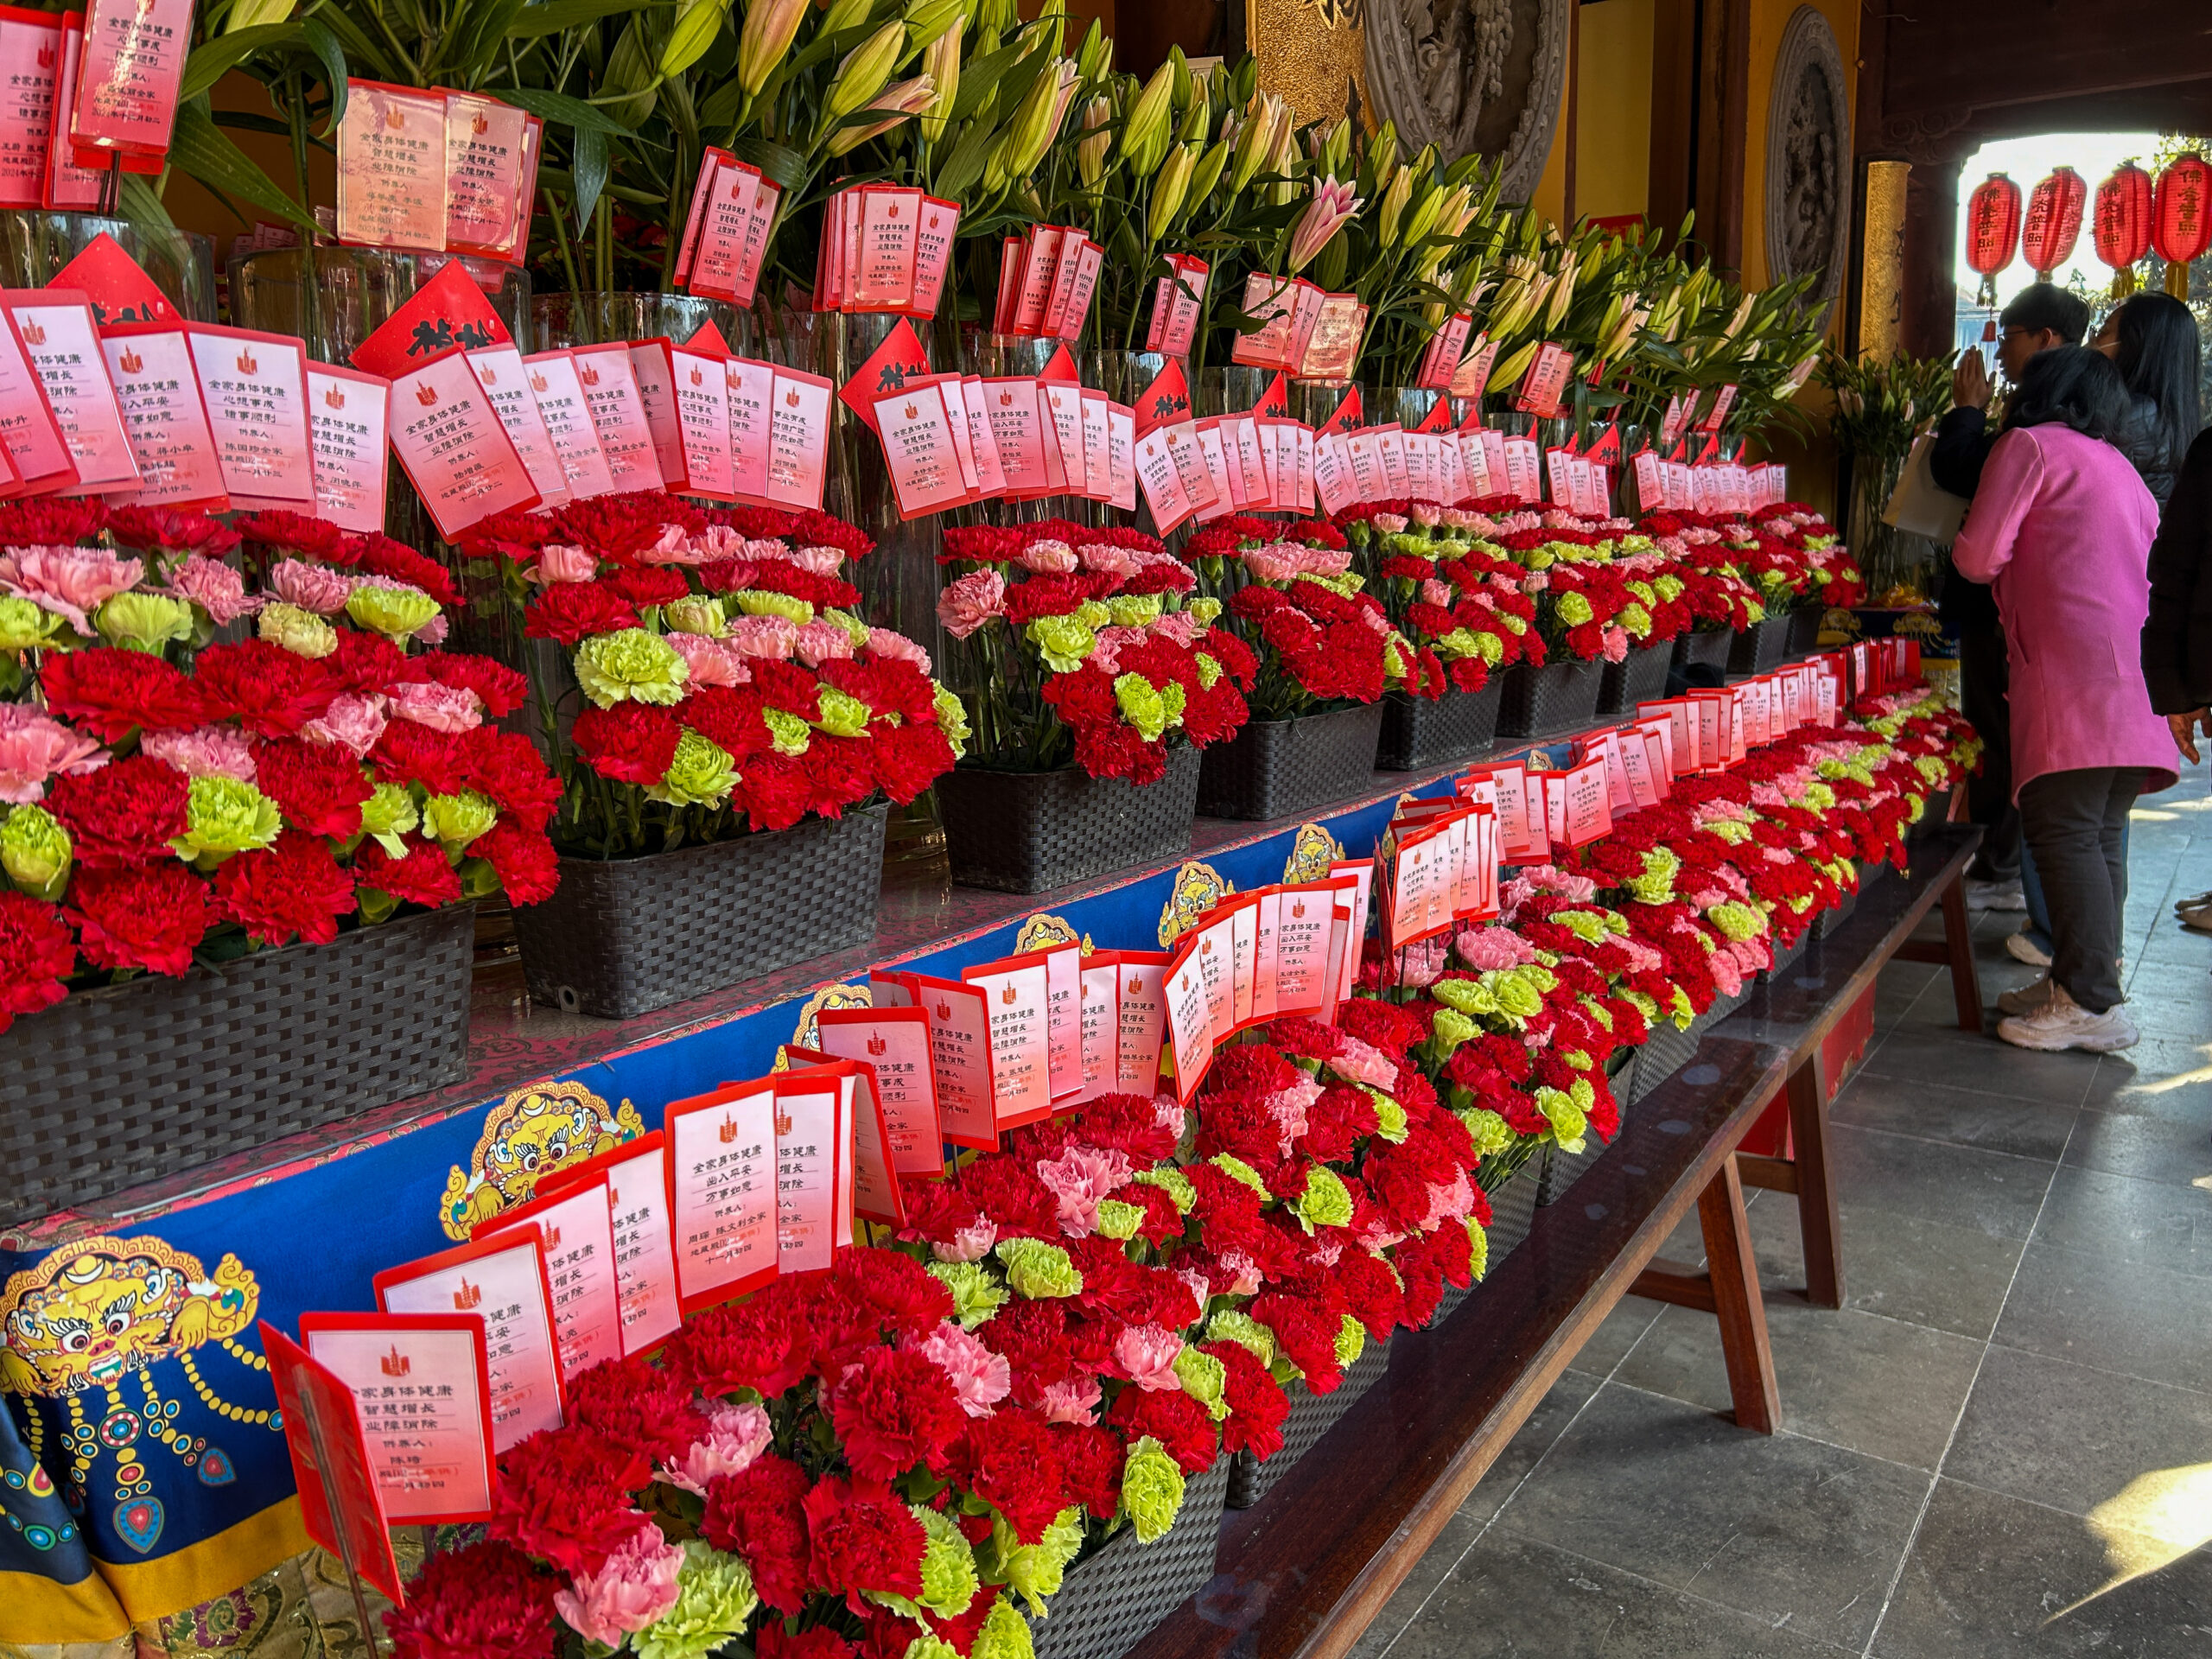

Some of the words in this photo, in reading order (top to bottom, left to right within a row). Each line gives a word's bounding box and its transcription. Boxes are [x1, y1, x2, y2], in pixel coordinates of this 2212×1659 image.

[109, 17, 173, 38] 全家体健康
[118, 35, 160, 51] 心事成
[208, 380, 285, 397] 全家身体健康
[224, 397, 275, 409] 心想事成
[498, 405, 518, 415] 增长
[226, 410, 276, 423] 诸事顺利
[405, 400, 472, 434] 全家身体健康
[423, 420, 467, 442] 智慧增长
[431, 431, 475, 455] 业障消除
[1279, 923, 1320, 933] 家身体健康
[993, 1024, 1027, 1038] 智慧增长
[878, 1077, 904, 1087] 事成
[693, 1144, 762, 1174] 全家身体健康
[706, 1165, 752, 1187] 出入平安
[706, 1180, 752, 1203] 万事如意
[548, 1243, 594, 1270] 体健康
[353, 1385, 453, 1398] 家身体健康
[364, 1403, 436, 1414] 智慧增长
[365, 1420, 437, 1431] 业障消除
